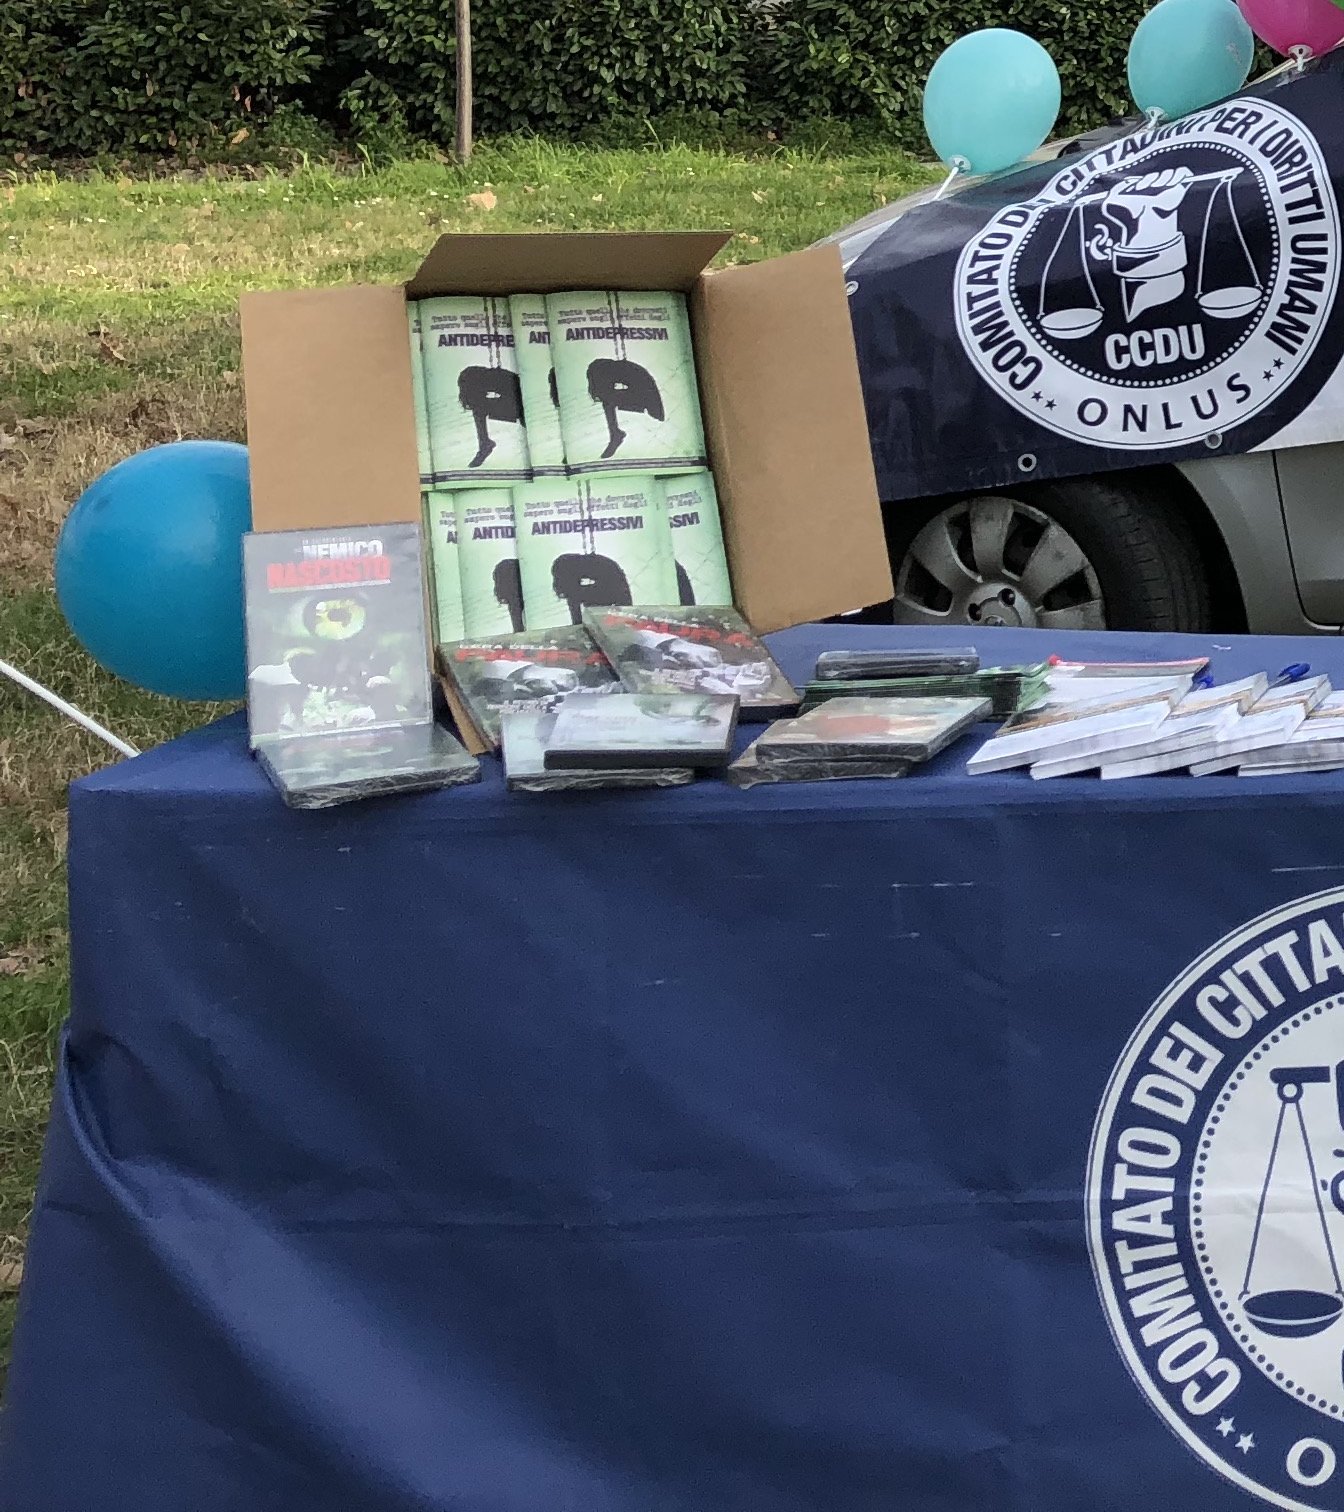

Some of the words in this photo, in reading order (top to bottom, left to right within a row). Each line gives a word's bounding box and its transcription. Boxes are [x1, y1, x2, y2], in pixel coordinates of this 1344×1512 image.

[1207, 107, 1264, 140] PER
[1249, 119, 1279, 144] I
[1258, 127, 1327, 226] DIRITTI
[965, 231, 1044, 393] COMITATO
[1264, 233, 1329, 357] UMANI
[565, 326, 669, 341] ANTIDEPRESSIVI
[1105, 323, 1205, 370] CCDU
[1077, 372, 1253, 432] ONLUS
[531, 515, 644, 536] ANTIDEPRESSIVI
[266, 555, 392, 589] NASCOSTO
[302, 540, 383, 560] NEMICO
[1129, 1018, 1223, 1124] DEI
[1111, 1125, 1242, 1416] COMITATO
